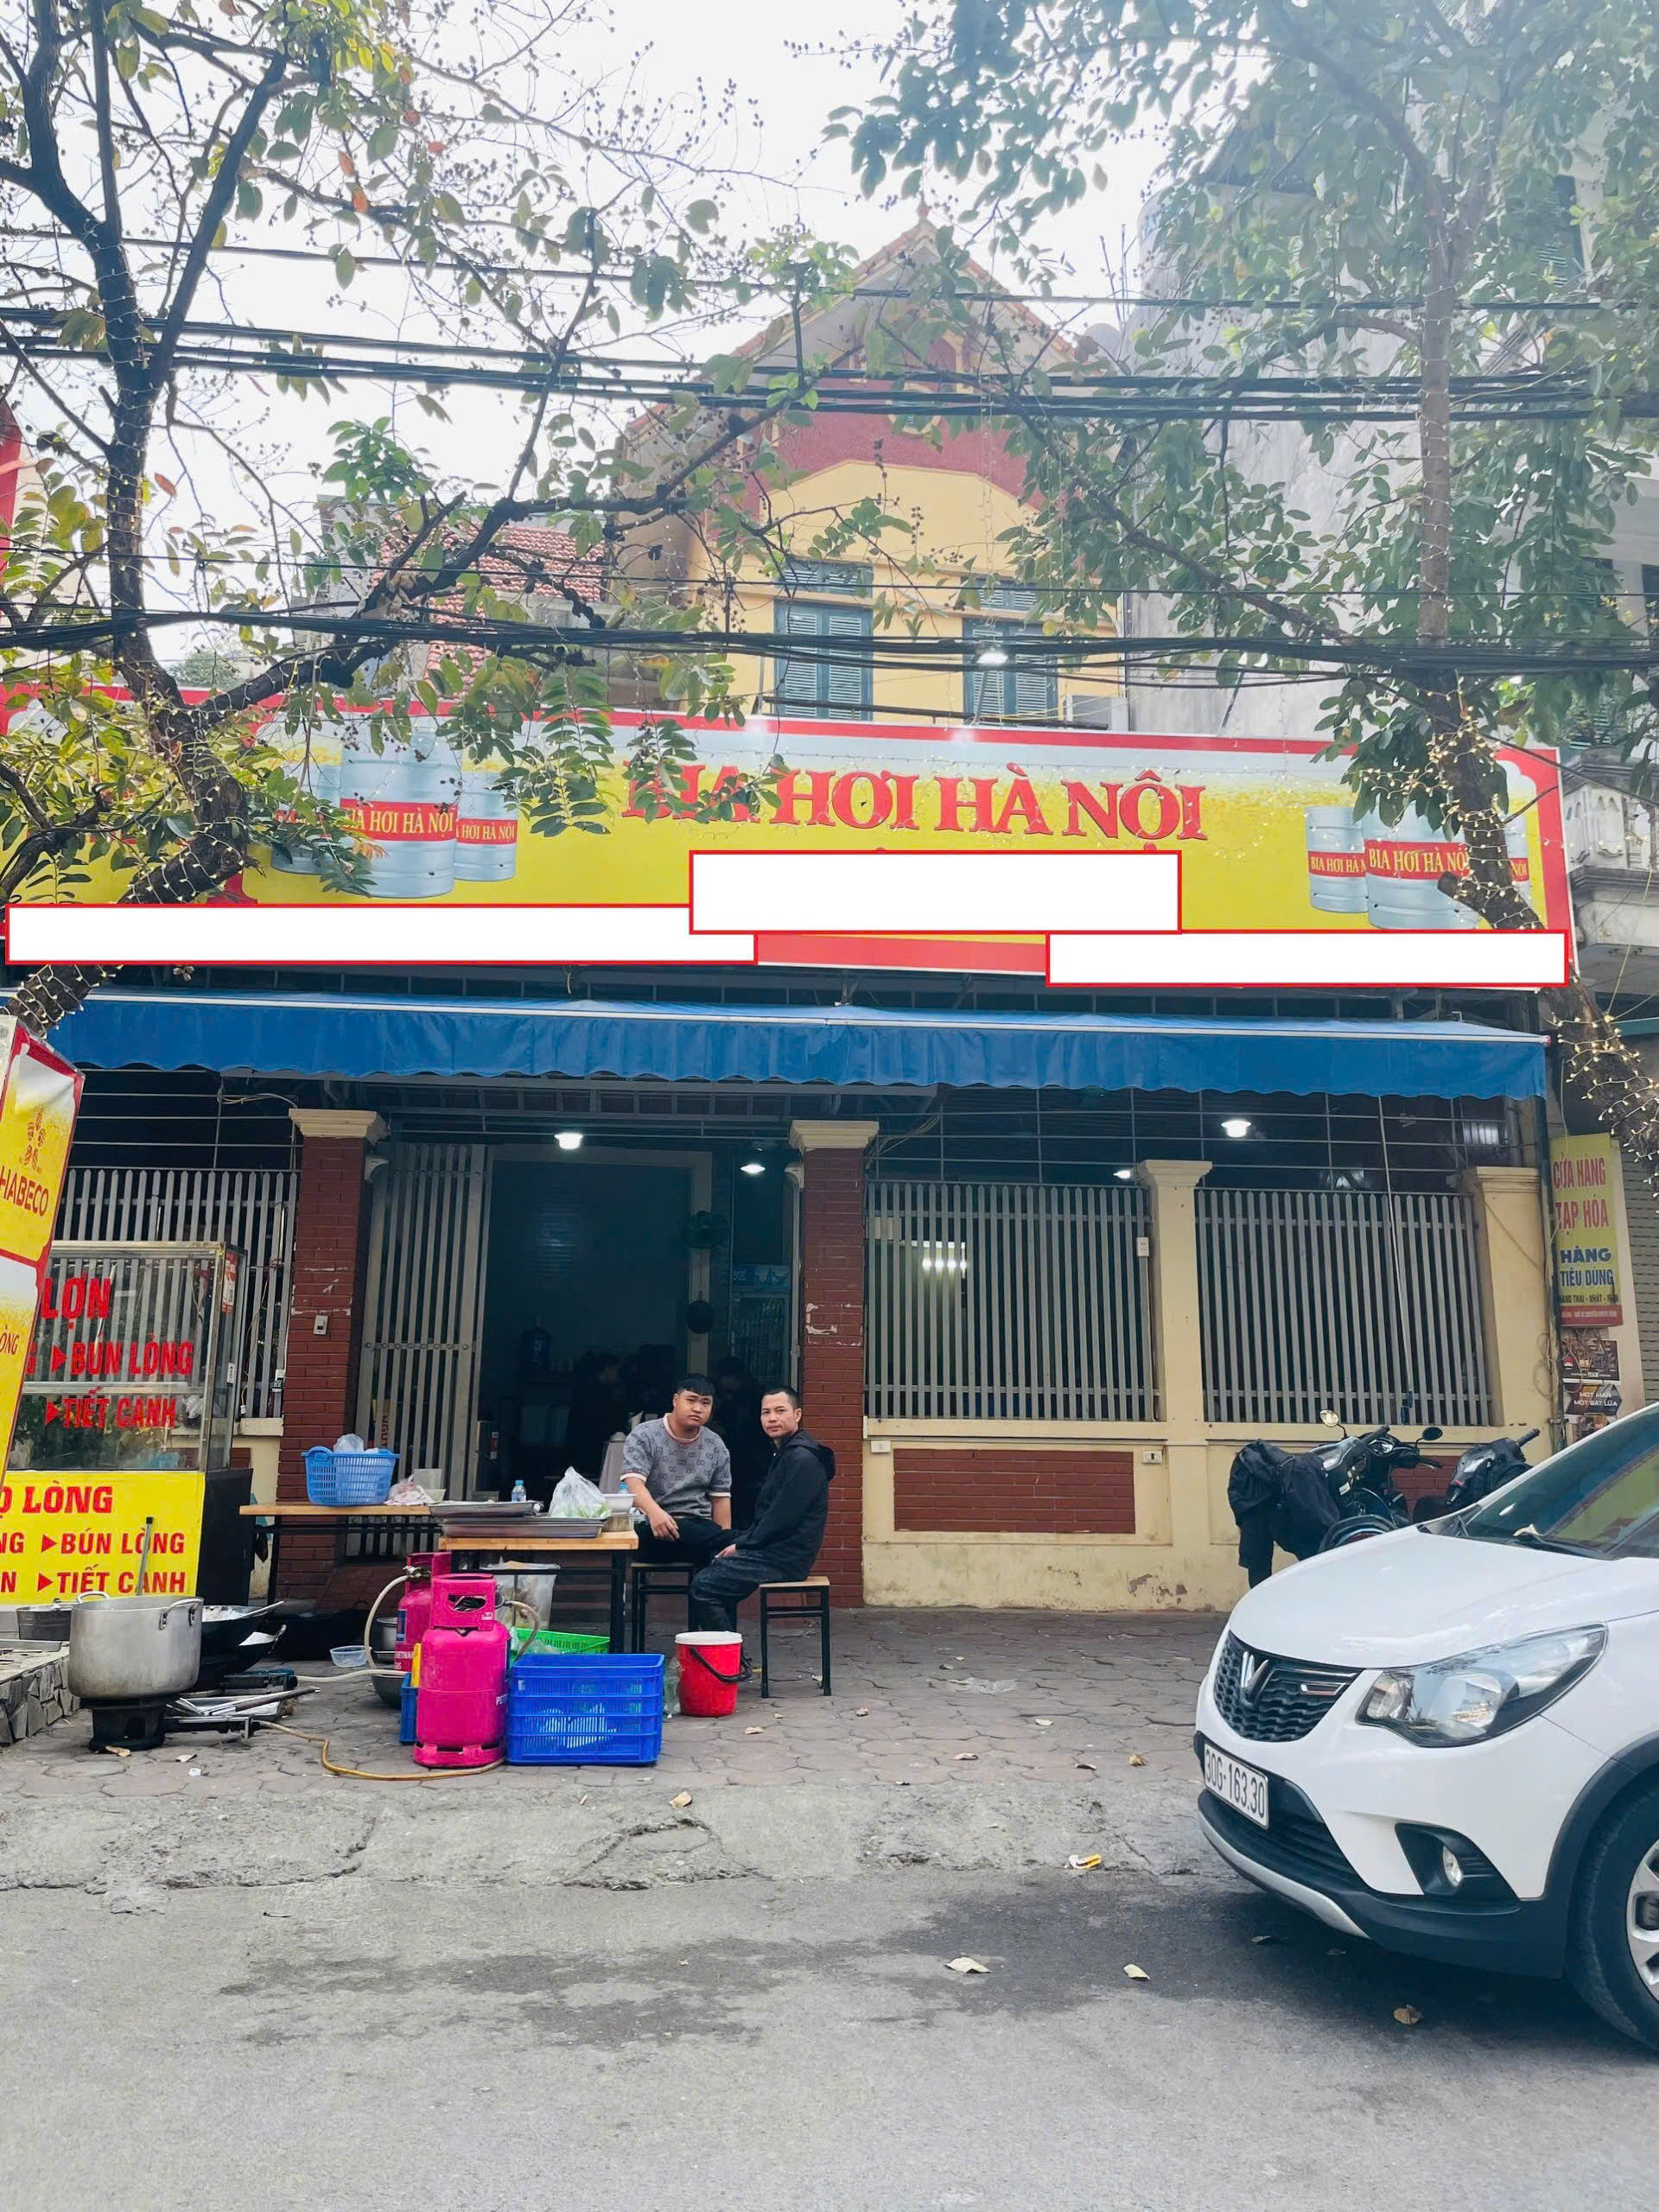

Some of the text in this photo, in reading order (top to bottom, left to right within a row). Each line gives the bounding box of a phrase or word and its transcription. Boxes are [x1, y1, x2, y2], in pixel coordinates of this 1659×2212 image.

[770, 766, 919, 830] HƠI
[934, 762, 1053, 836] HÀ
[1061, 768, 1207, 851] NỘI
[370, 810, 398, 834] HƠI
[403, 808, 423, 834] HÀ
[428, 810, 454, 839] NỘI
[483, 822, 496, 840] HÀ
[1311, 856, 1325, 871] BIA
[1326, 857, 1344, 873] HƠI
[1345, 855, 1359, 873] HÀ
[1369, 848, 1390, 870] BIA
[1394, 849, 1420, 873] HƠI
[1424, 847, 1444, 873] HÀ
[1576, 1153, 1605, 1187] HÀNG
[0, 1165, 48, 1217] HABECO
[1555, 1192, 1609, 1236] TẠP HÓA
[1560, 1245, 1611, 1263] HÀNG
[1560, 1266, 1613, 1287] TIÊU DÙNG
[41, 1272, 111, 1329] LỢN
[71, 1332, 121, 1376] BÚN
[130, 1332, 194, 1376] LÒNG
[62, 1386, 177, 1429] TIẾT CANH
[22, 1480, 113, 1514] LÒNG
[60, 1528, 111, 1554] BÚN
[57, 1564, 110, 1593] TIẾT
